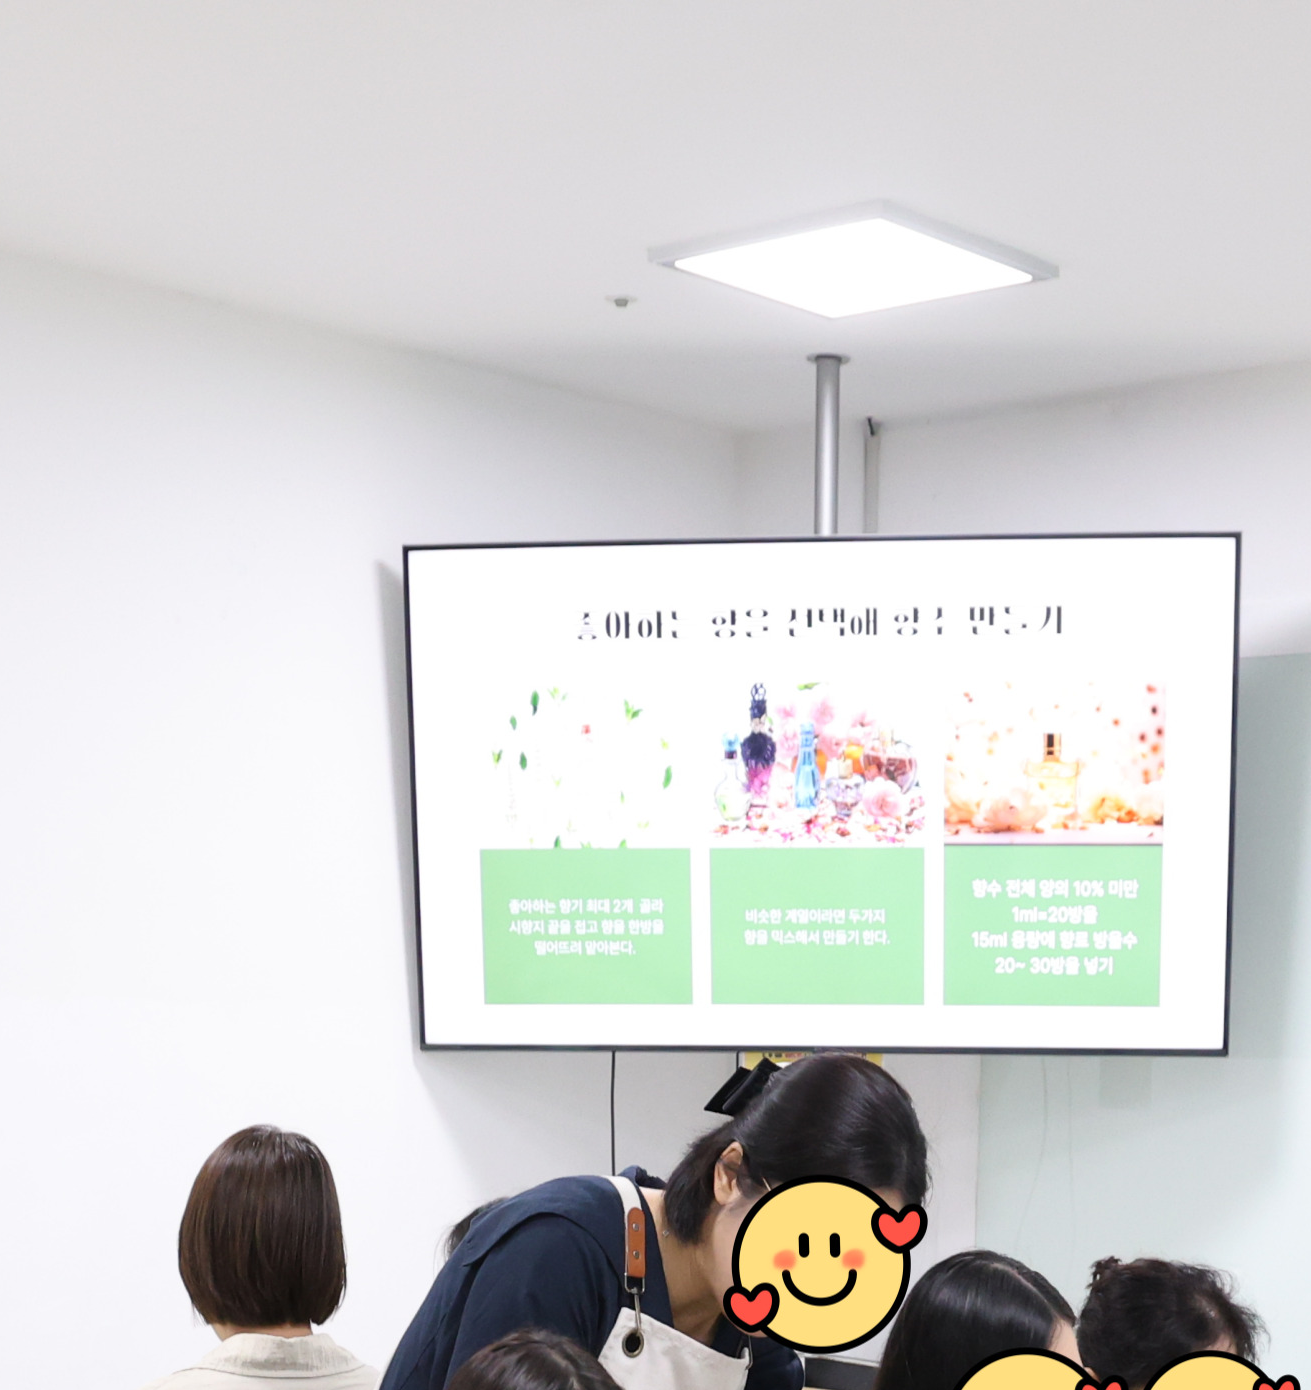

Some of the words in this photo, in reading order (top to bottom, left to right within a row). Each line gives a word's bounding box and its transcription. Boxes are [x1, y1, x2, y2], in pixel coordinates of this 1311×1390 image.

[972, 878, 1002, 898] 향수
[1006, 878, 1036, 898] 전체
[1039, 878, 1069, 898] 양의
[1073, 878, 1104, 898] 10%
[1108, 878, 1139, 898] 미만
[509, 898, 556, 914] 좋아하는
[559, 898, 583, 914] 향기
[586, 898, 610, 914] 최대
[613, 898, 634, 914] 2개
[639, 898, 664, 914] 골라
[745, 909, 782, 925] 비슷한
[849, 909, 886, 925] 두가지
[509, 919, 545, 935] 시향지
[547, 919, 571, 935] 끝을
[574, 919, 598, 935] 접고
[601, 919, 625, 935] 향을
[628, 919, 664, 935] 한방울
[744, 929, 768, 946] 향을
[771, 929, 820, 946] 믹스해서
[822, 929, 860, 946] 만들기
[862, 929, 891, 946] 한다.
[971, 930, 1008, 950] 15ml
[1011, 930, 1056, 950] 용량에
[1093, 930, 1138, 950] 방울수
[994, 956, 1026, 976] 20~
[1030, 956, 1080, 976] 30방울
[1083, 956, 1113, 976] 넣기
